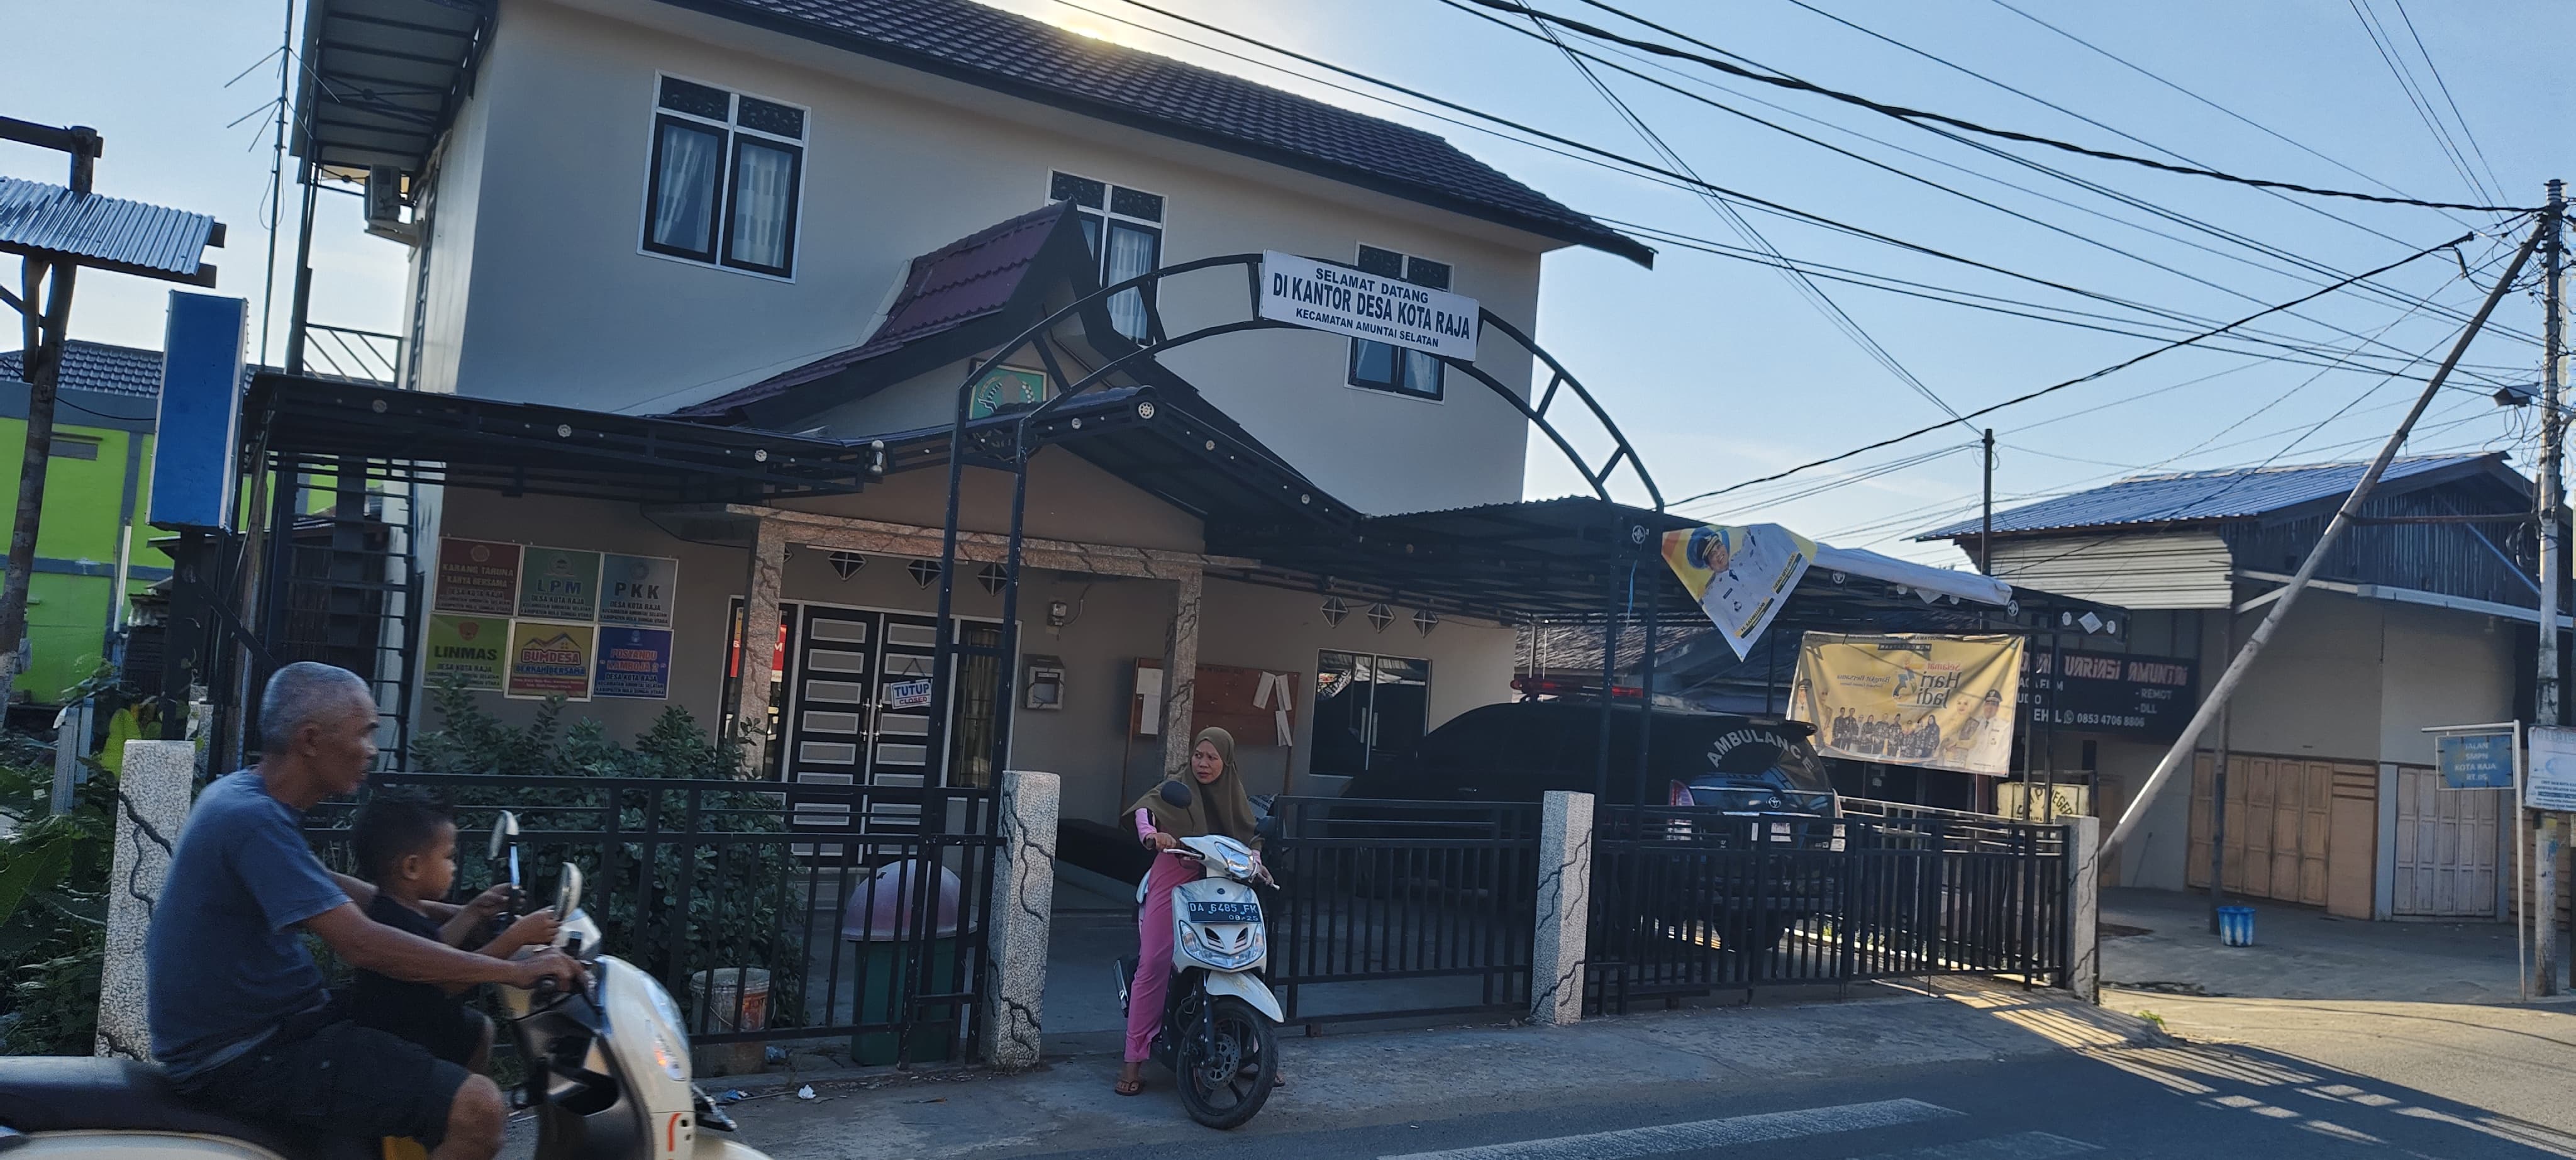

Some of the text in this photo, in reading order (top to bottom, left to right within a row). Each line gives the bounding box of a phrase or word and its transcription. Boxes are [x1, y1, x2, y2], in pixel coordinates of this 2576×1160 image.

[1316, 268, 1428, 303] SELAMAT DATANG
[1274, 272, 1469, 339] DI KANTOR DESA KOTA RAJA
[1296, 308, 1438, 347] KECAMATAN AMUNTAI SELATAN
[443, 564, 514, 576] KARANG TARUNA
[614, 583, 660, 599] PKK
[434, 646, 497, 660] LINMAS
[523, 650, 580, 664] BUMDESA
[610, 649, 658, 661] POSYANDU
[549, 667, 586, 676] BERSAMA
[894, 684, 929, 696] TUTUP
[2140, 703, 2157, 714] DLL
[2077, 713, 2098, 723] 0853
[2101, 715, 2121, 725] 4706
[1707, 729, 1814, 772] AMBULANCE
[2455, 763, 2475, 771] KOTA
[1189, 903, 1258, 913] DA 6485 FK
